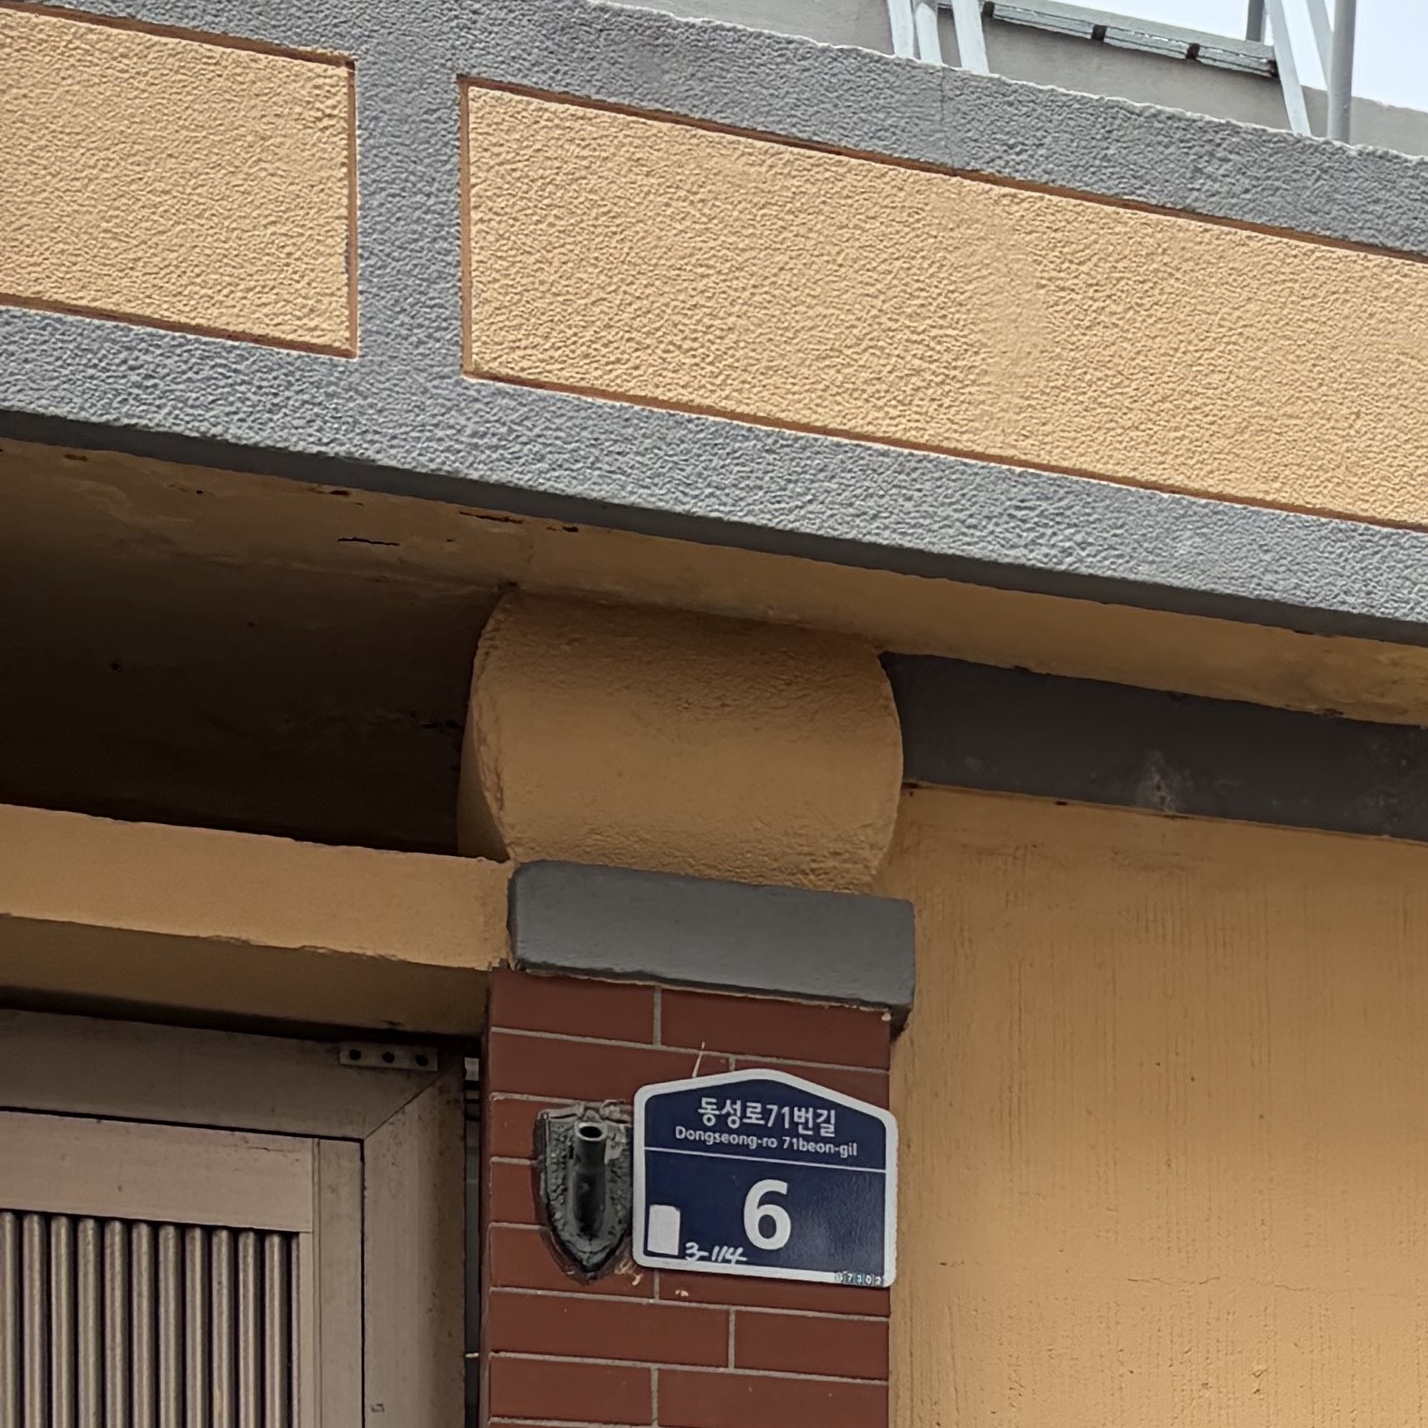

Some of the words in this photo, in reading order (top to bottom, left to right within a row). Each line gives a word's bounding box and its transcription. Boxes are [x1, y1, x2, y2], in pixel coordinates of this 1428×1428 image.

[697, 1096, 837, 1138] 동성로71번길
[675, 1125, 778, 1150] Dongseong-ro
[781, 1135, 858, 1158] 71beon-gil
[742, 1178, 792, 1251] 6
[685, 1241, 749, 1265] 3-114
